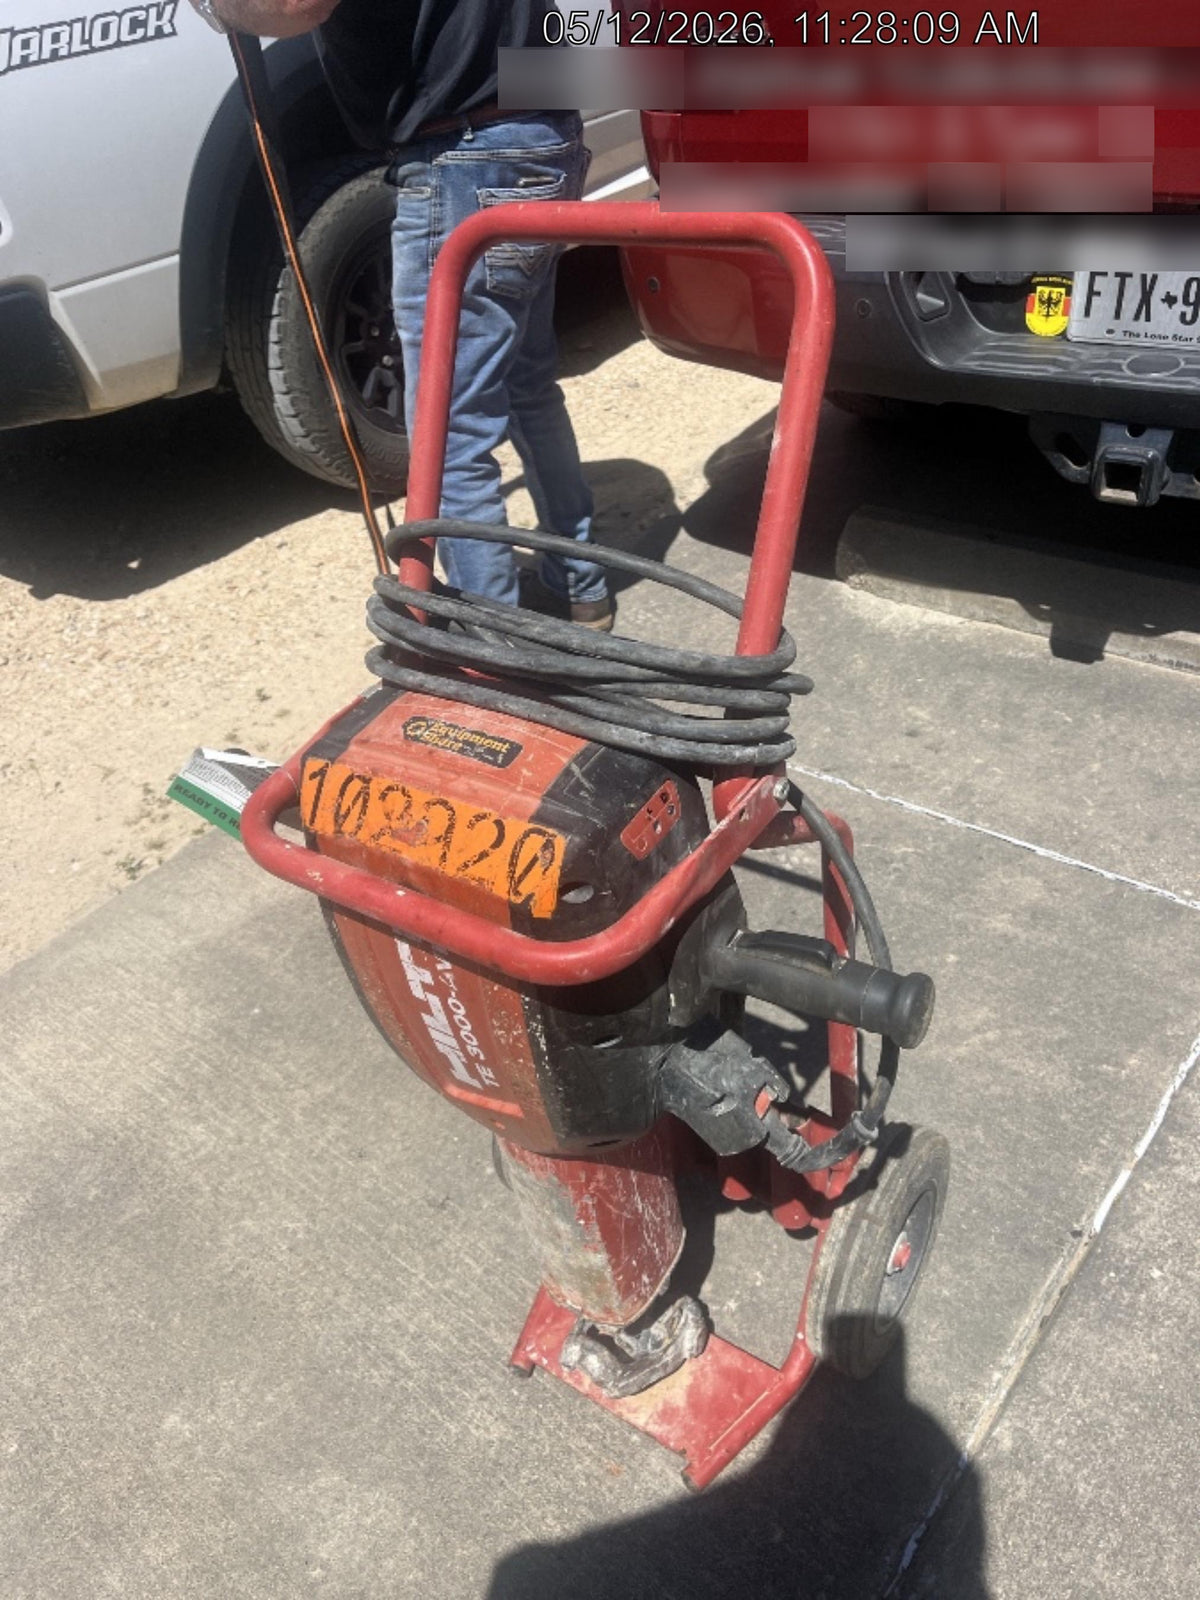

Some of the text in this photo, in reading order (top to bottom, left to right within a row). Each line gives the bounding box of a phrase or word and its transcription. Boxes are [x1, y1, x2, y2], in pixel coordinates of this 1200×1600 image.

[1122, 330, 1141, 339] The
[1144, 331, 1169, 340] Lone
[1172, 333, 1195, 343] Star
[173, 784, 212, 808] READY
[212, 807, 228, 820] TO
[394, 938, 484, 1090] HILT
[474, 1062, 500, 1088] TE
